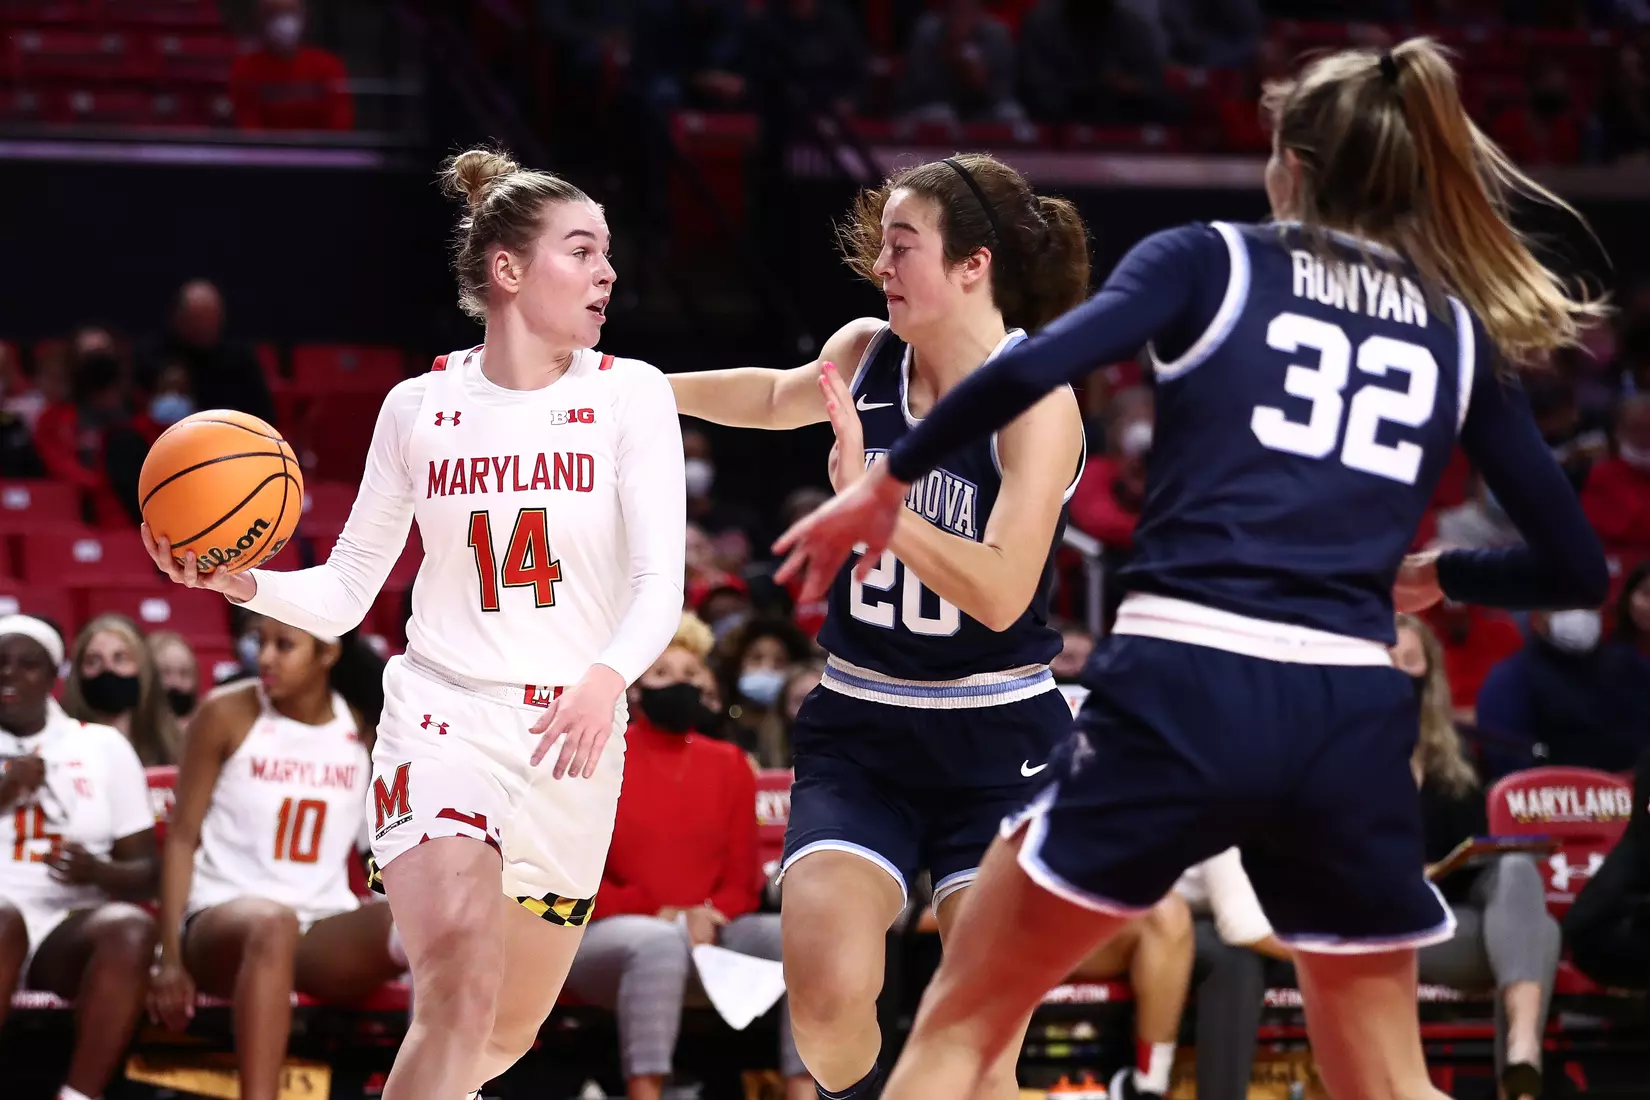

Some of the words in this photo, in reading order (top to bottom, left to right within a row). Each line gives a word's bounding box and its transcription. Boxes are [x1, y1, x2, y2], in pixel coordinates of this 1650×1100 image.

[1291, 249, 1428, 328] RUNYAN
[1250, 312, 1439, 485] 32
[426, 452, 595, 499] MARYLAND
[467, 507, 563, 612] 14
[850, 542, 961, 637] 20
[250, 757, 357, 790] MARYLAND
[373, 761, 413, 833] M
[1505, 786, 1632, 818] MARYLAND
[273, 797, 328, 864] 10
